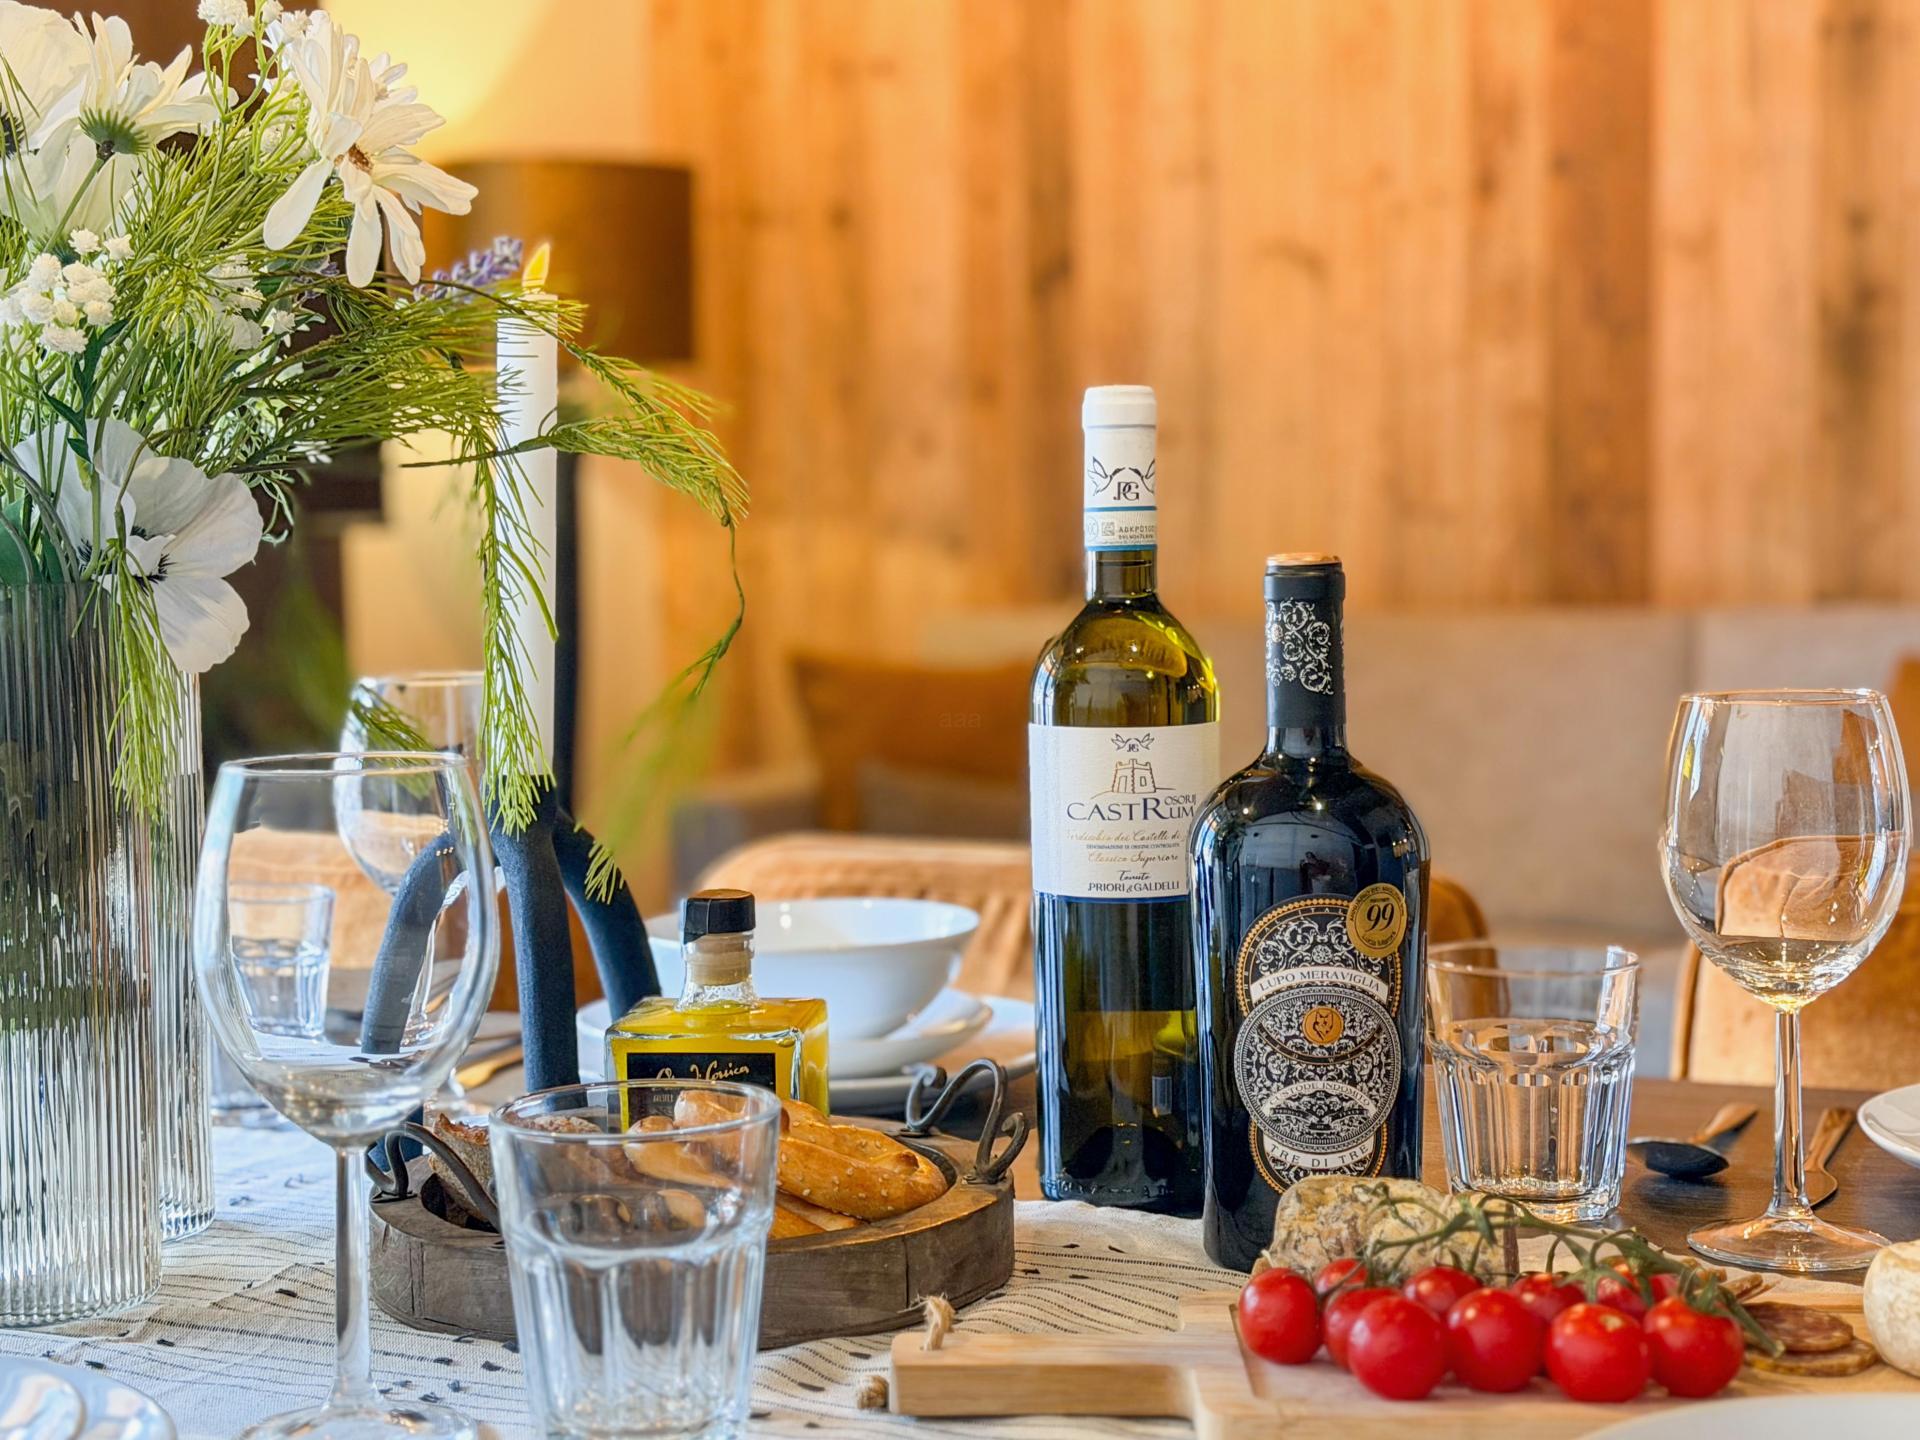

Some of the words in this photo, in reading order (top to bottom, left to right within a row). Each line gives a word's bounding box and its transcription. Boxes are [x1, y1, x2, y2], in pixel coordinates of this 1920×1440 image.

[1365, 902, 1395, 932] 99
[1260, 972, 1296, 992] LUPO
[1300, 970, 1381, 992] MERAVIGLIA
[1322, 1082, 1371, 1106] INDOMITO
[1271, 1144, 1301, 1164] TRE
[1311, 1158, 1329, 1168] DI
[1339, 1144, 1370, 1164] TRE
